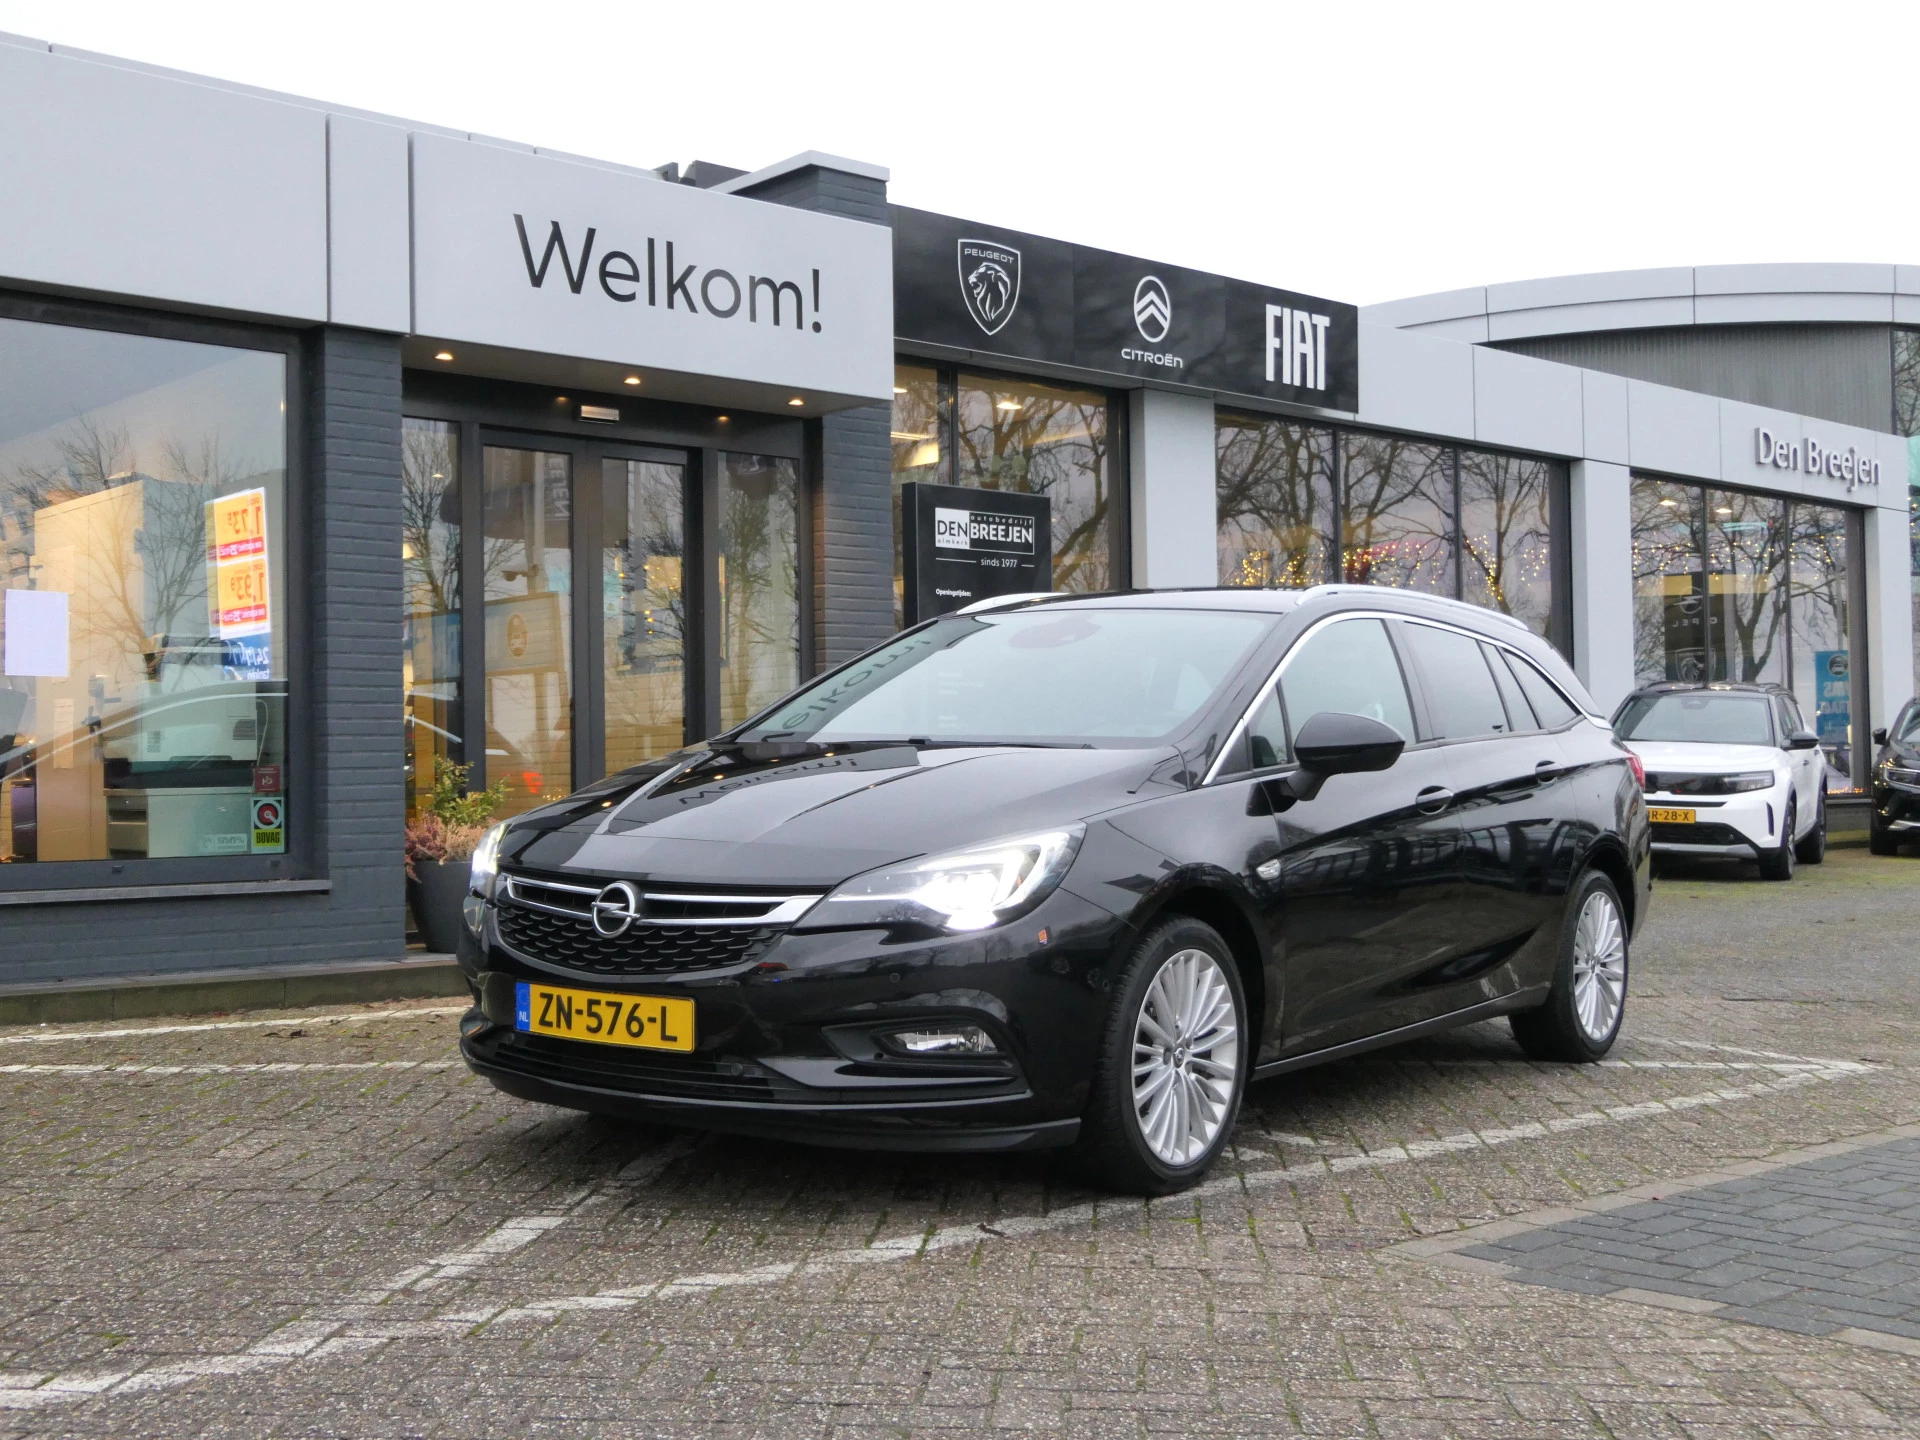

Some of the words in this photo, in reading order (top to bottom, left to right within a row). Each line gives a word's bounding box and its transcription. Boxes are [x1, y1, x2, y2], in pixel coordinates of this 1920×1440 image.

[964, 248, 1015, 264] PEUGEOT
[513, 213, 822, 333] Welkom!
[1266, 303, 1330, 391] FIAT
[1755, 427, 1801, 472] Den
[1803, 437, 1881, 493] Breejen
[937, 519, 969, 539] DEN
[970, 522, 1033, 544] BREEJEN
[970, 514, 1033, 526] autobedrijf
[980, 557, 1000, 567] sinds
[1001, 558, 1018, 568] 1977
[256, 831, 280, 844] BOVAG
[519, 1011, 529, 1022] NL
[538, 992, 678, 1042] ZN-576-L
